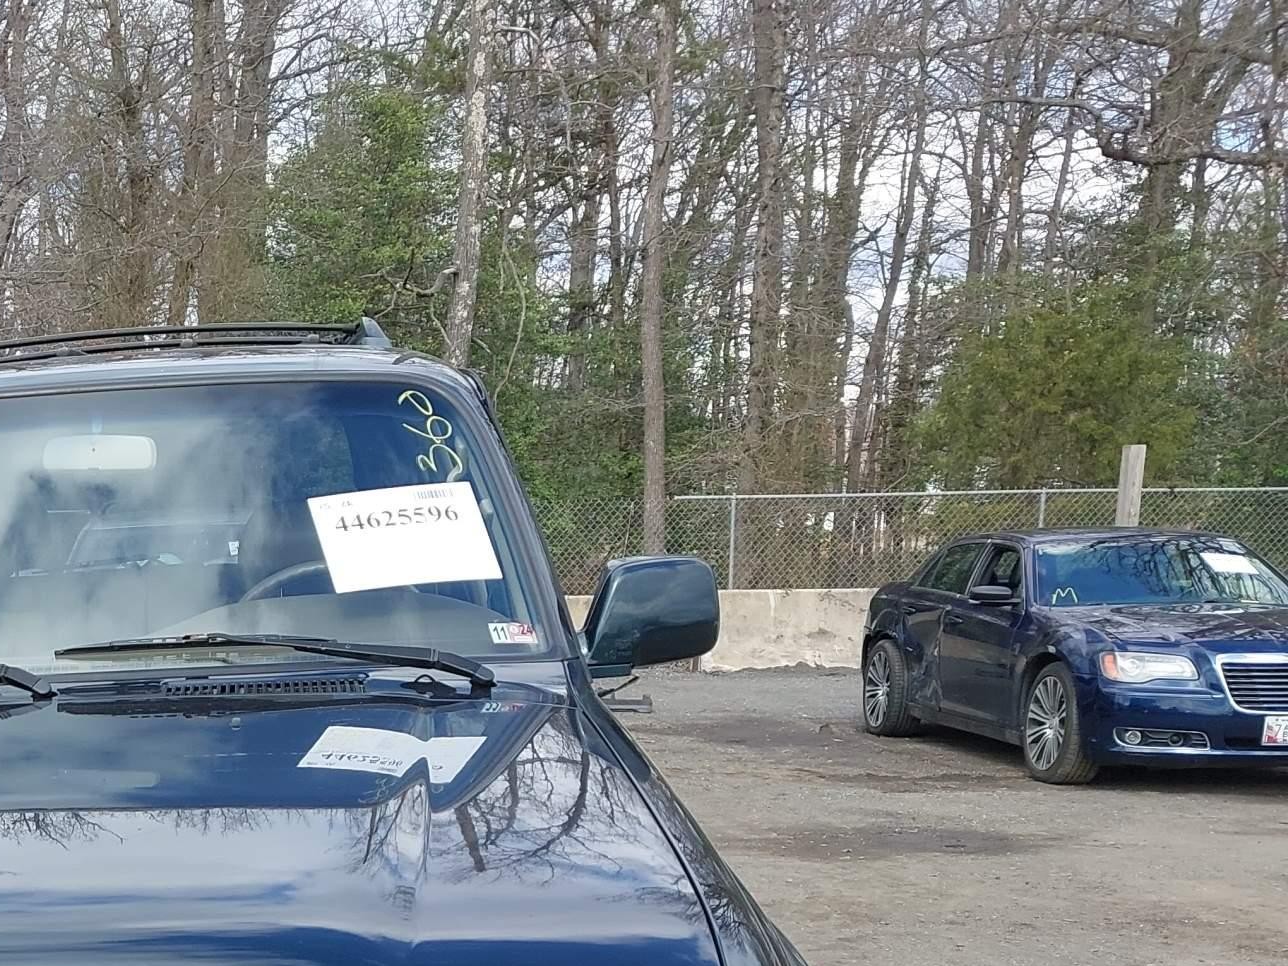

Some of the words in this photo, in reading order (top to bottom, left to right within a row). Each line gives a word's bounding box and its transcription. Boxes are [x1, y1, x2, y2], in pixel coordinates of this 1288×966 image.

[335, 503, 460, 532] 44625596
[1051, 587, 1079, 605] M
[492, 625, 508, 641] 11
